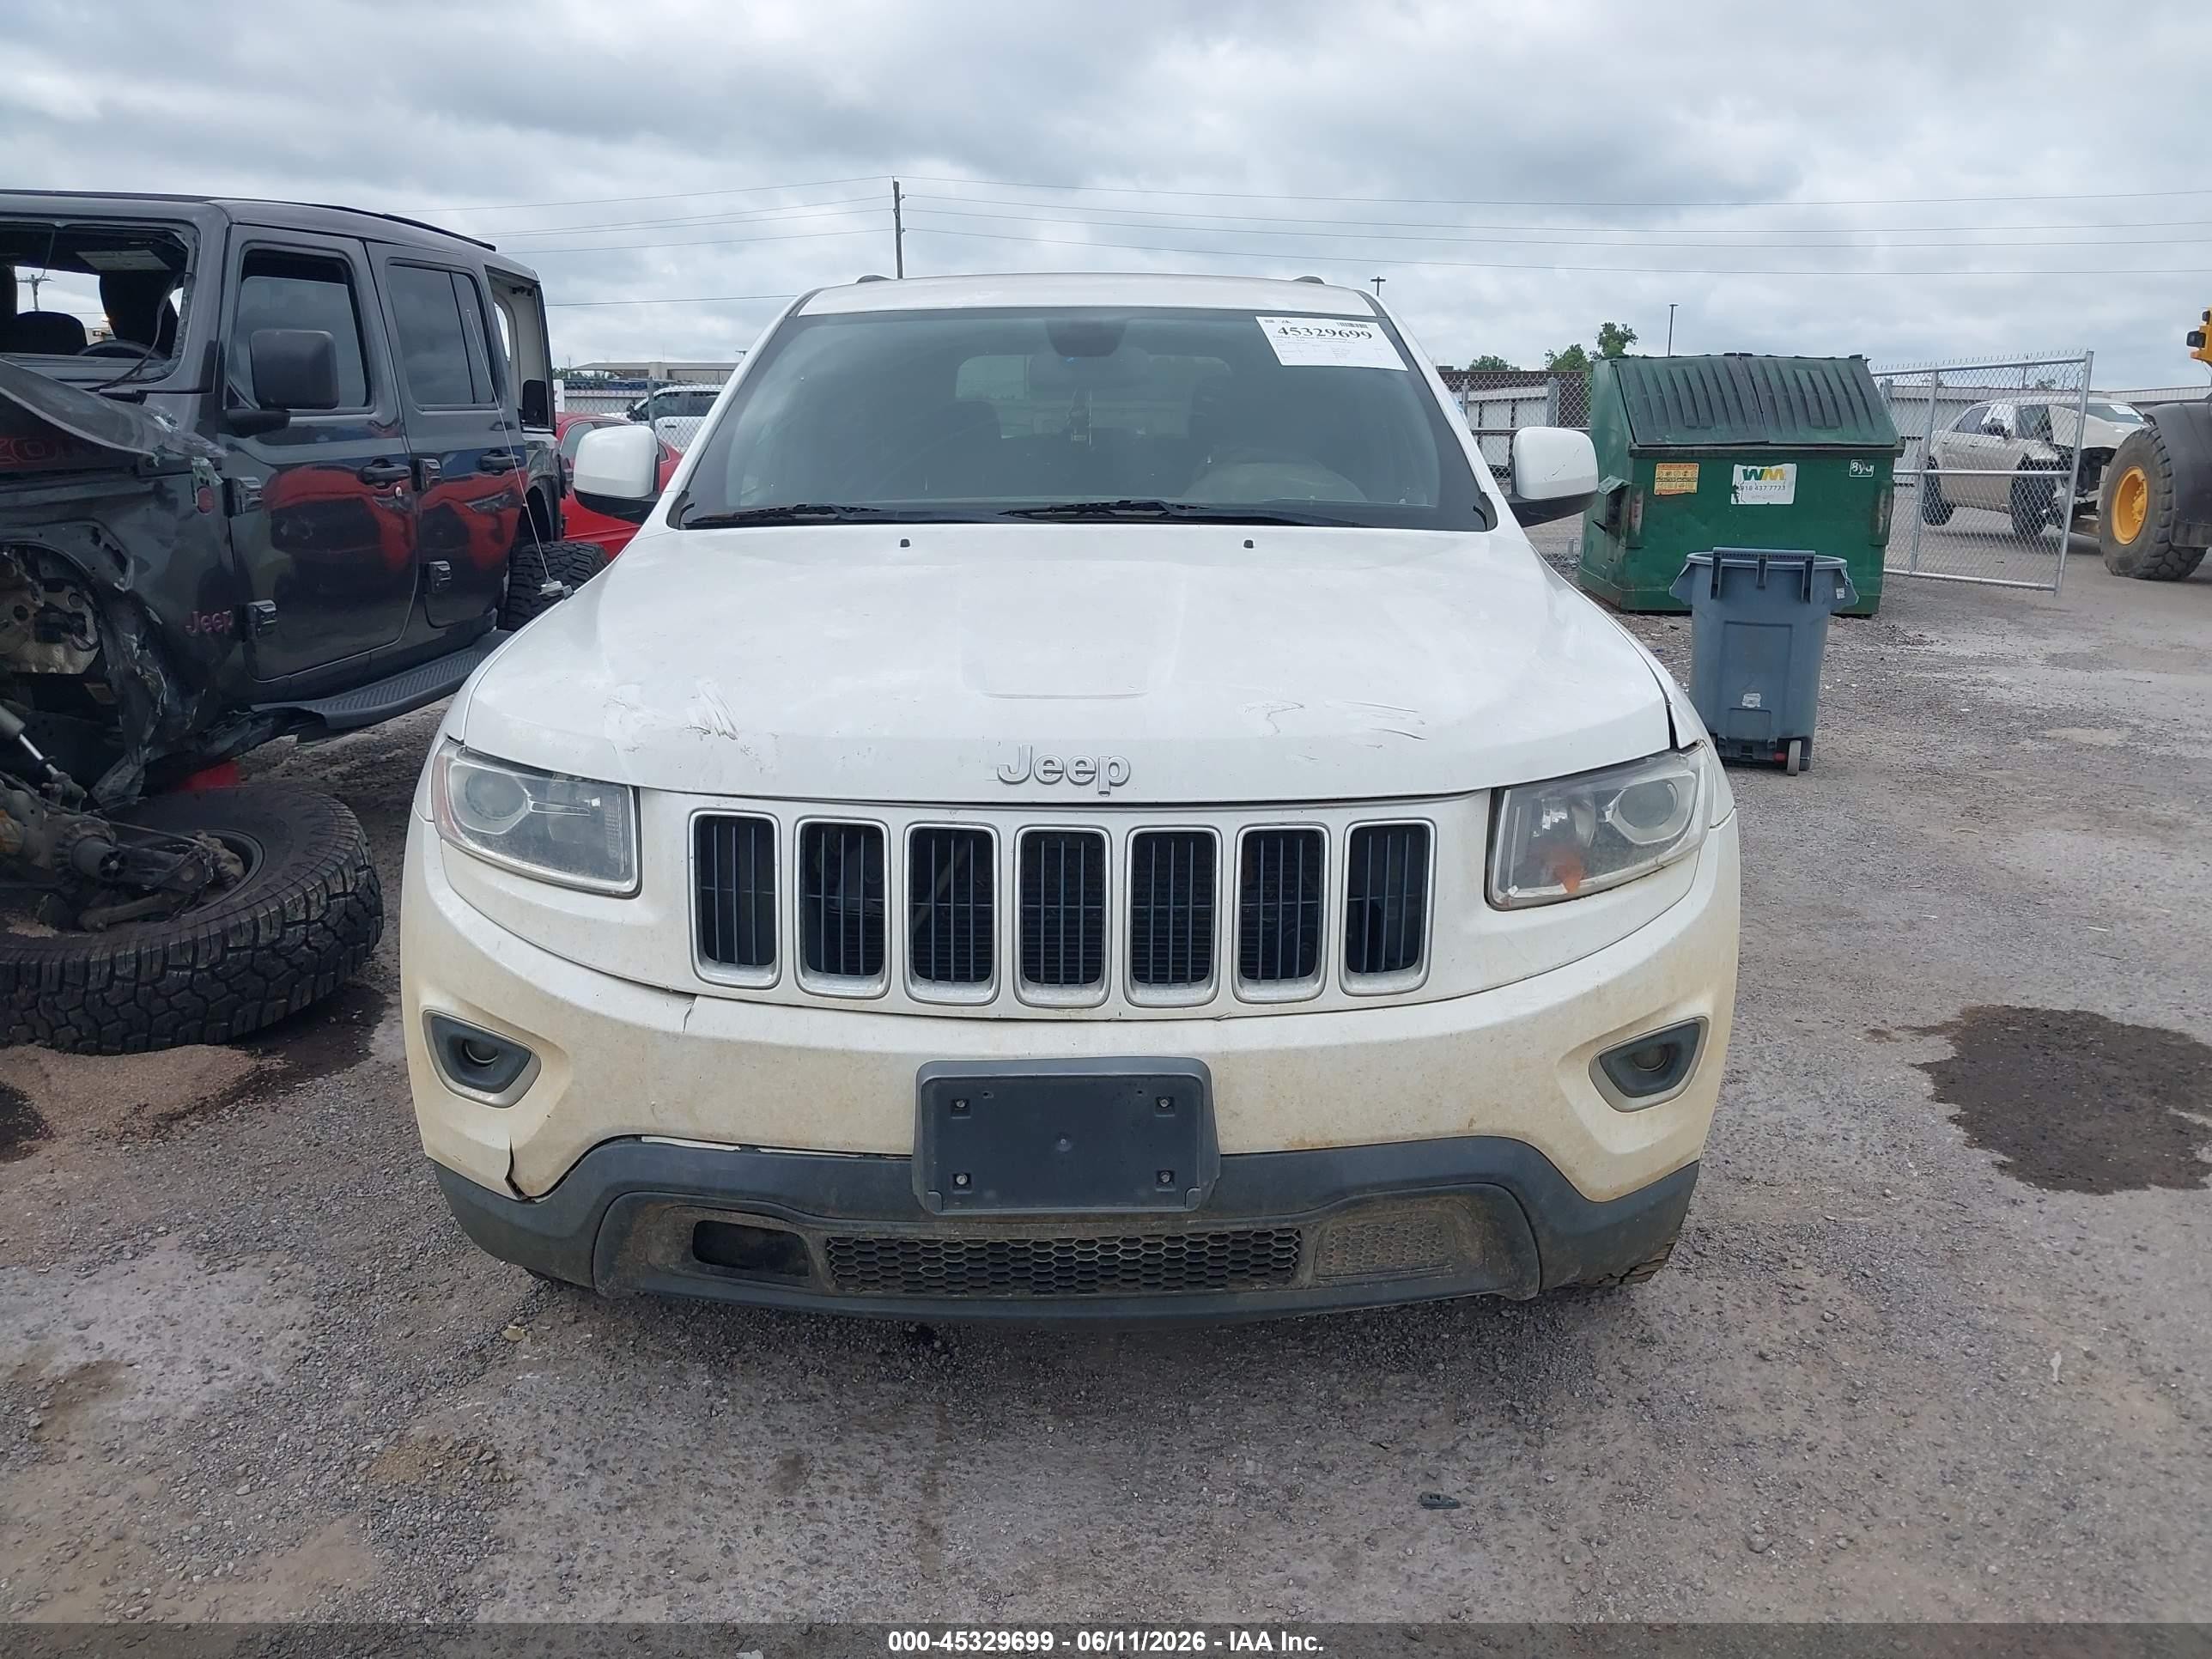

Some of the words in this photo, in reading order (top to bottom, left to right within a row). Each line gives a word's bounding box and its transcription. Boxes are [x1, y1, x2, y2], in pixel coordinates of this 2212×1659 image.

[1277, 326, 1373, 340] 45329699
[1742, 468, 1786, 481] WM
[185, 610, 234, 634] Jeep
[997, 744, 1131, 797] Jeep
